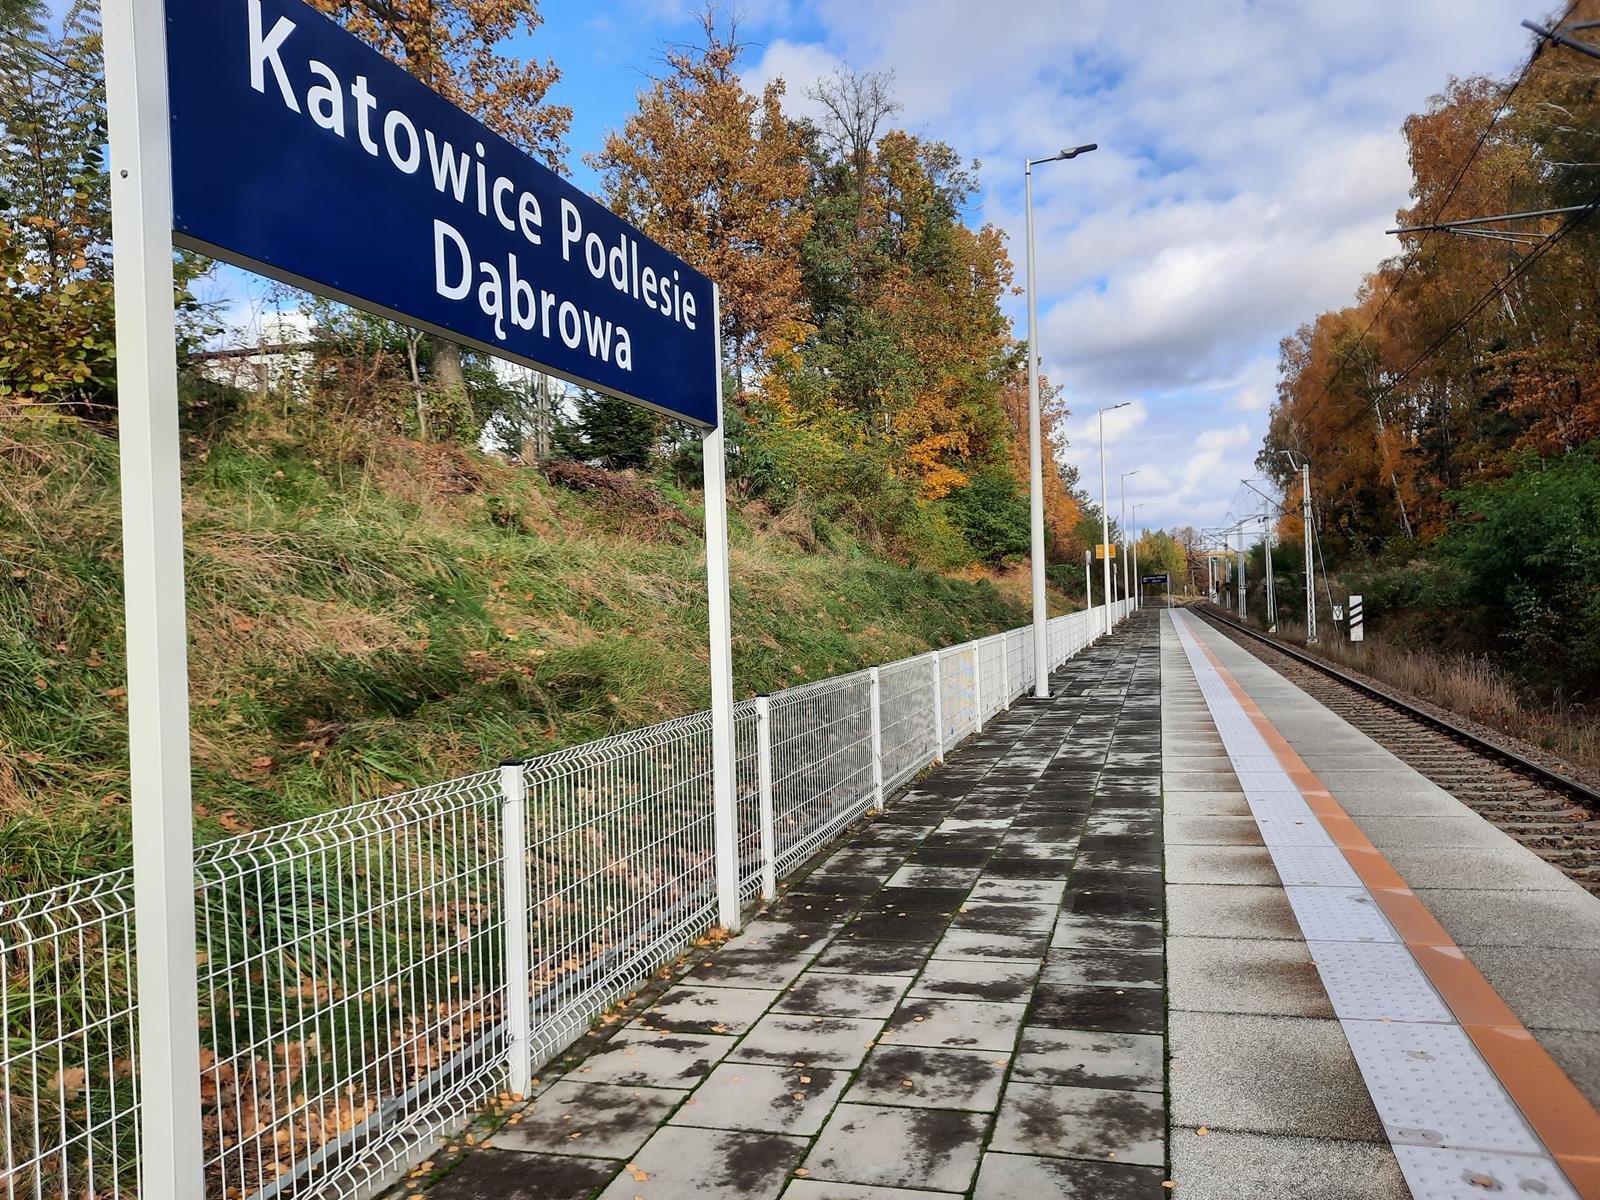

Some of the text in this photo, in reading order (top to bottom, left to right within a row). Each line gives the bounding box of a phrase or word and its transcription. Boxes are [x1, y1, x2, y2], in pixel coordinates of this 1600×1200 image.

[248, 0, 697, 331] Katowice Podlesie
[433, 218, 632, 372] Dąbrowa
